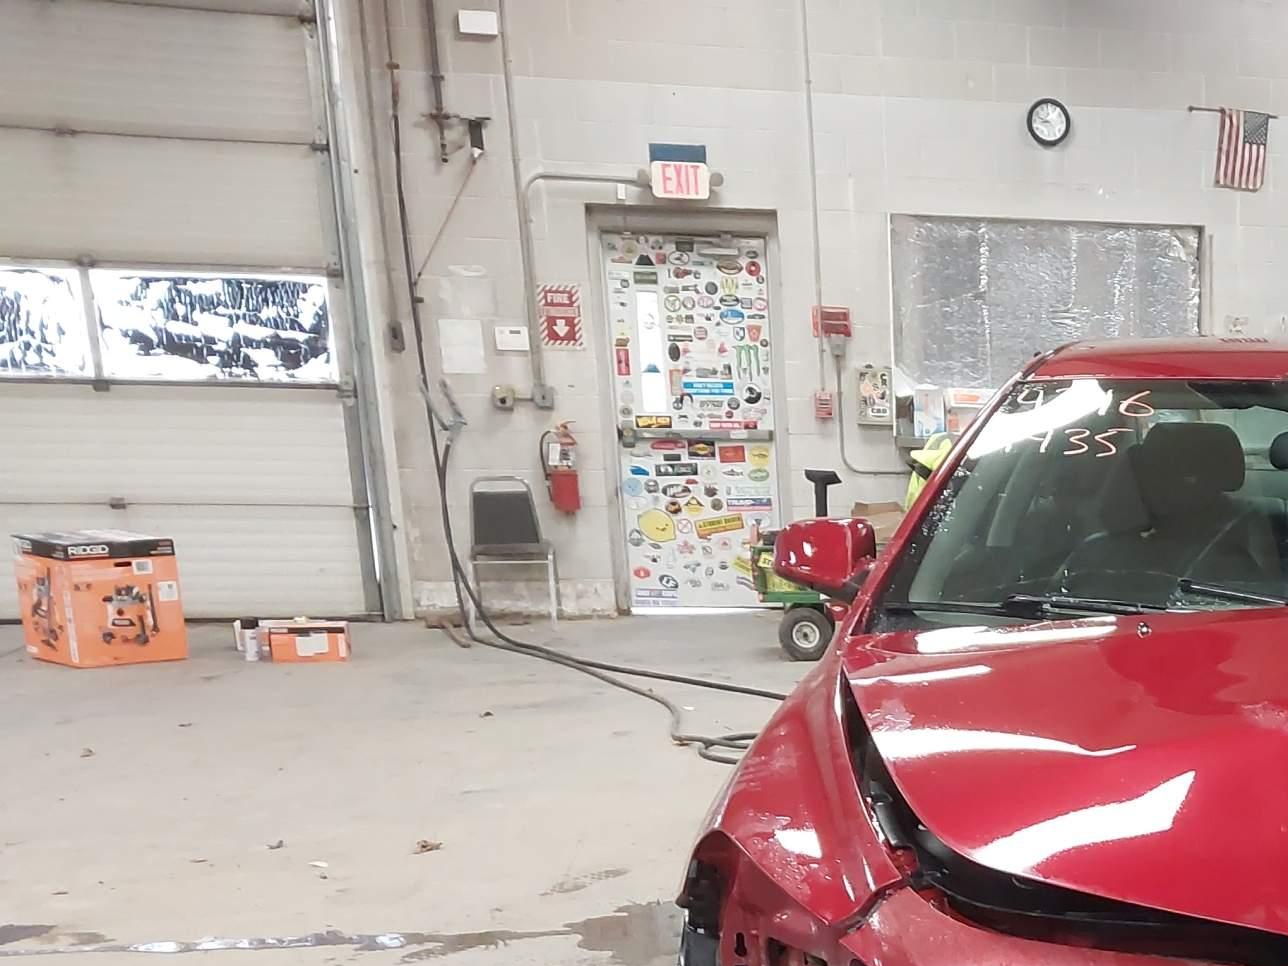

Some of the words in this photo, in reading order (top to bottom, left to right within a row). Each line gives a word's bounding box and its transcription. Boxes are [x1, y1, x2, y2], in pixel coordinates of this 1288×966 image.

[660, 163, 700, 195] EXIT
[546, 292, 570, 304] FIRE
[67, 544, 110, 556] RIDGID
